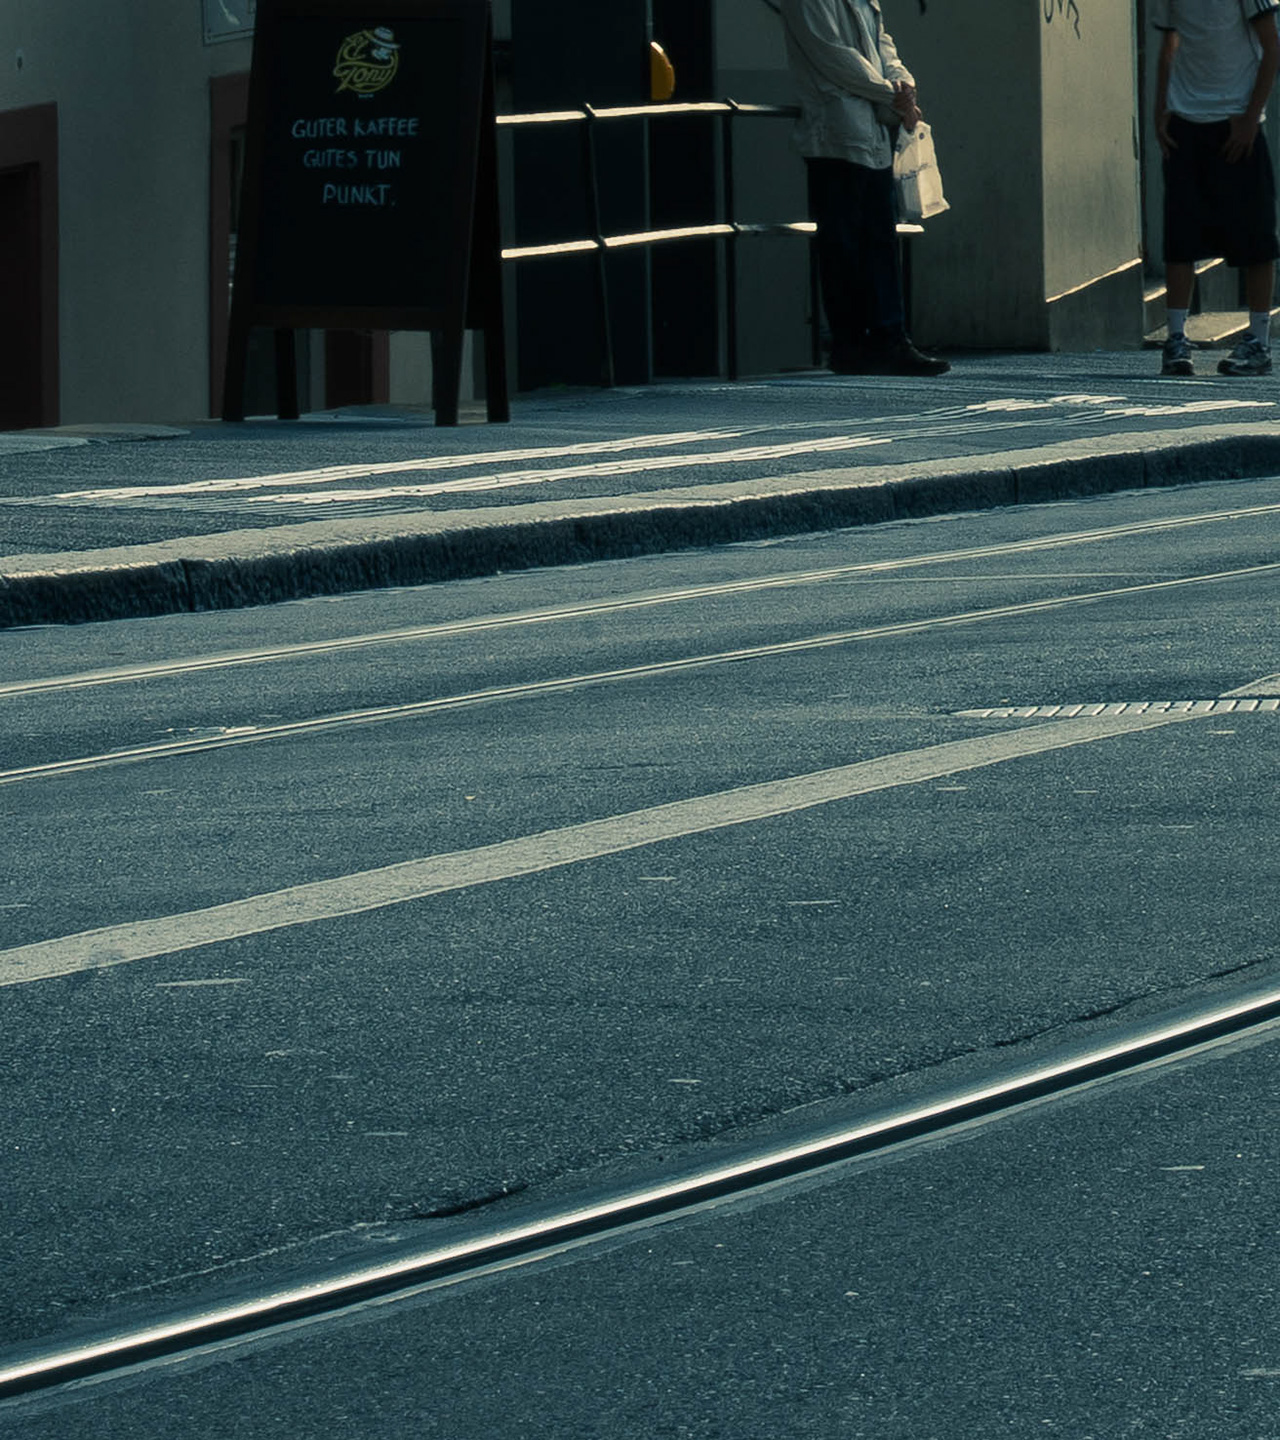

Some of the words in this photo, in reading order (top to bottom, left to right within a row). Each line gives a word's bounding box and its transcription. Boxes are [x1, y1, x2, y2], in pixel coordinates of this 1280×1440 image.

[290, 116, 350, 139] GUTER
[353, 116, 420, 138] KAFFEE
[303, 148, 359, 169] GUTES
[365, 148, 403, 170] TUN
[321, 182, 398, 208] PUNKT.
